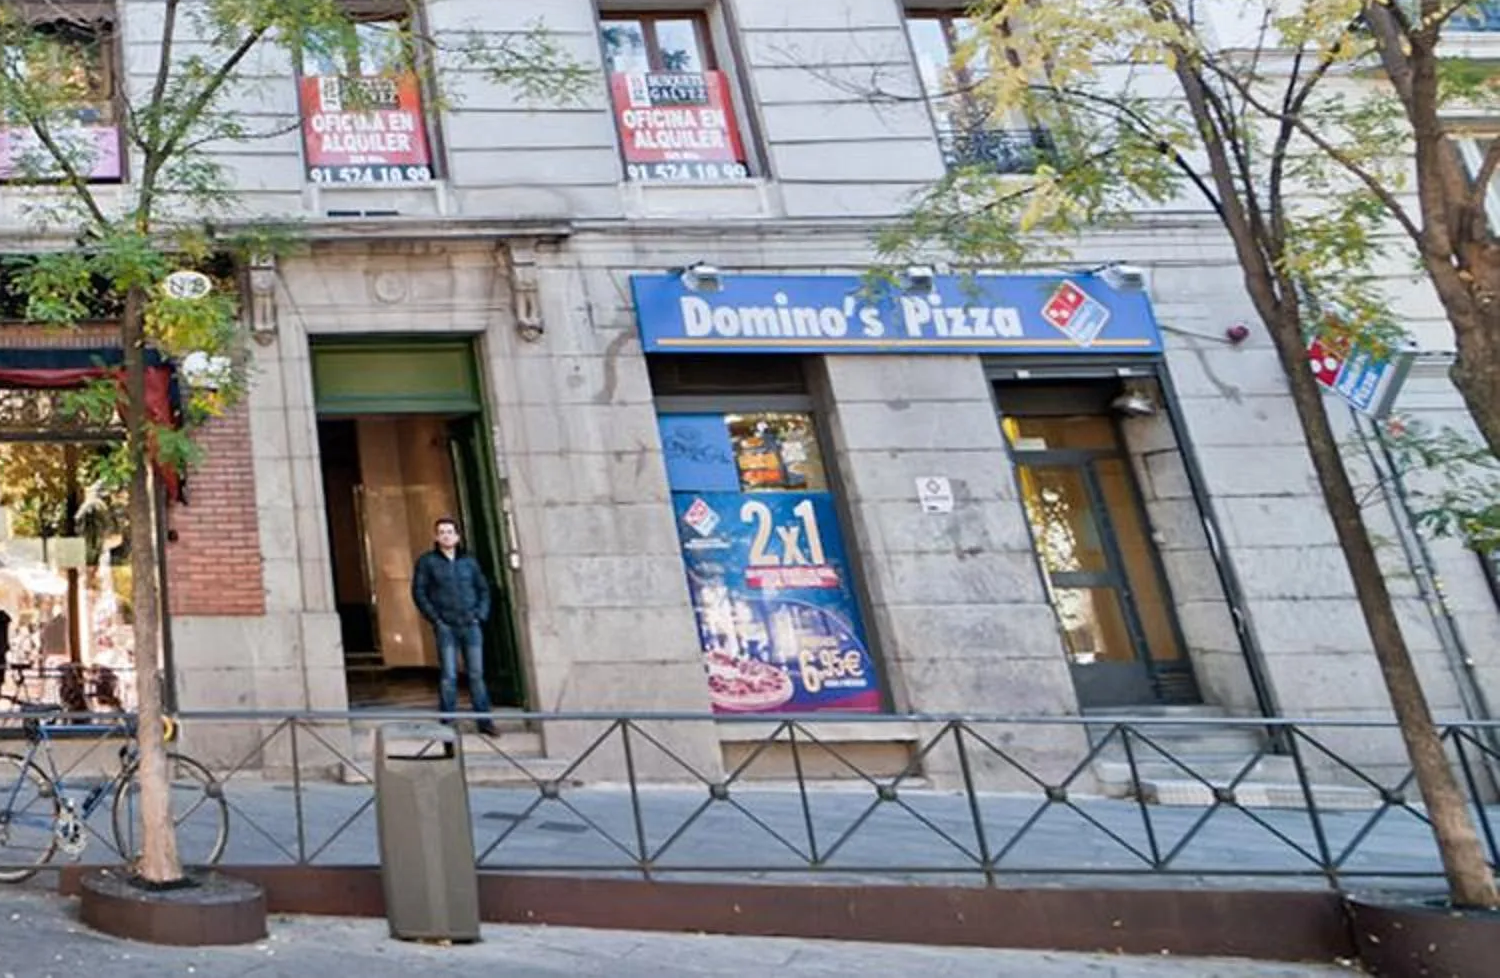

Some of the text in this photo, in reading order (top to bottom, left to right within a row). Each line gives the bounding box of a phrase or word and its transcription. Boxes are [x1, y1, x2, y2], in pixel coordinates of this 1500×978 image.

[388, 113, 414, 131] EN
[623, 109, 726, 129] OFICINA EN
[321, 133, 411, 153] ALQUILER
[634, 129, 726, 149] ALQUILER
[310, 167, 431, 182] 91 524 10 99
[627, 164, 748, 179] 91 524 10 99
[680, 292, 884, 338] Domino's
[903, 294, 1024, 338] Pizza
[740, 499, 827, 566] 2x1
